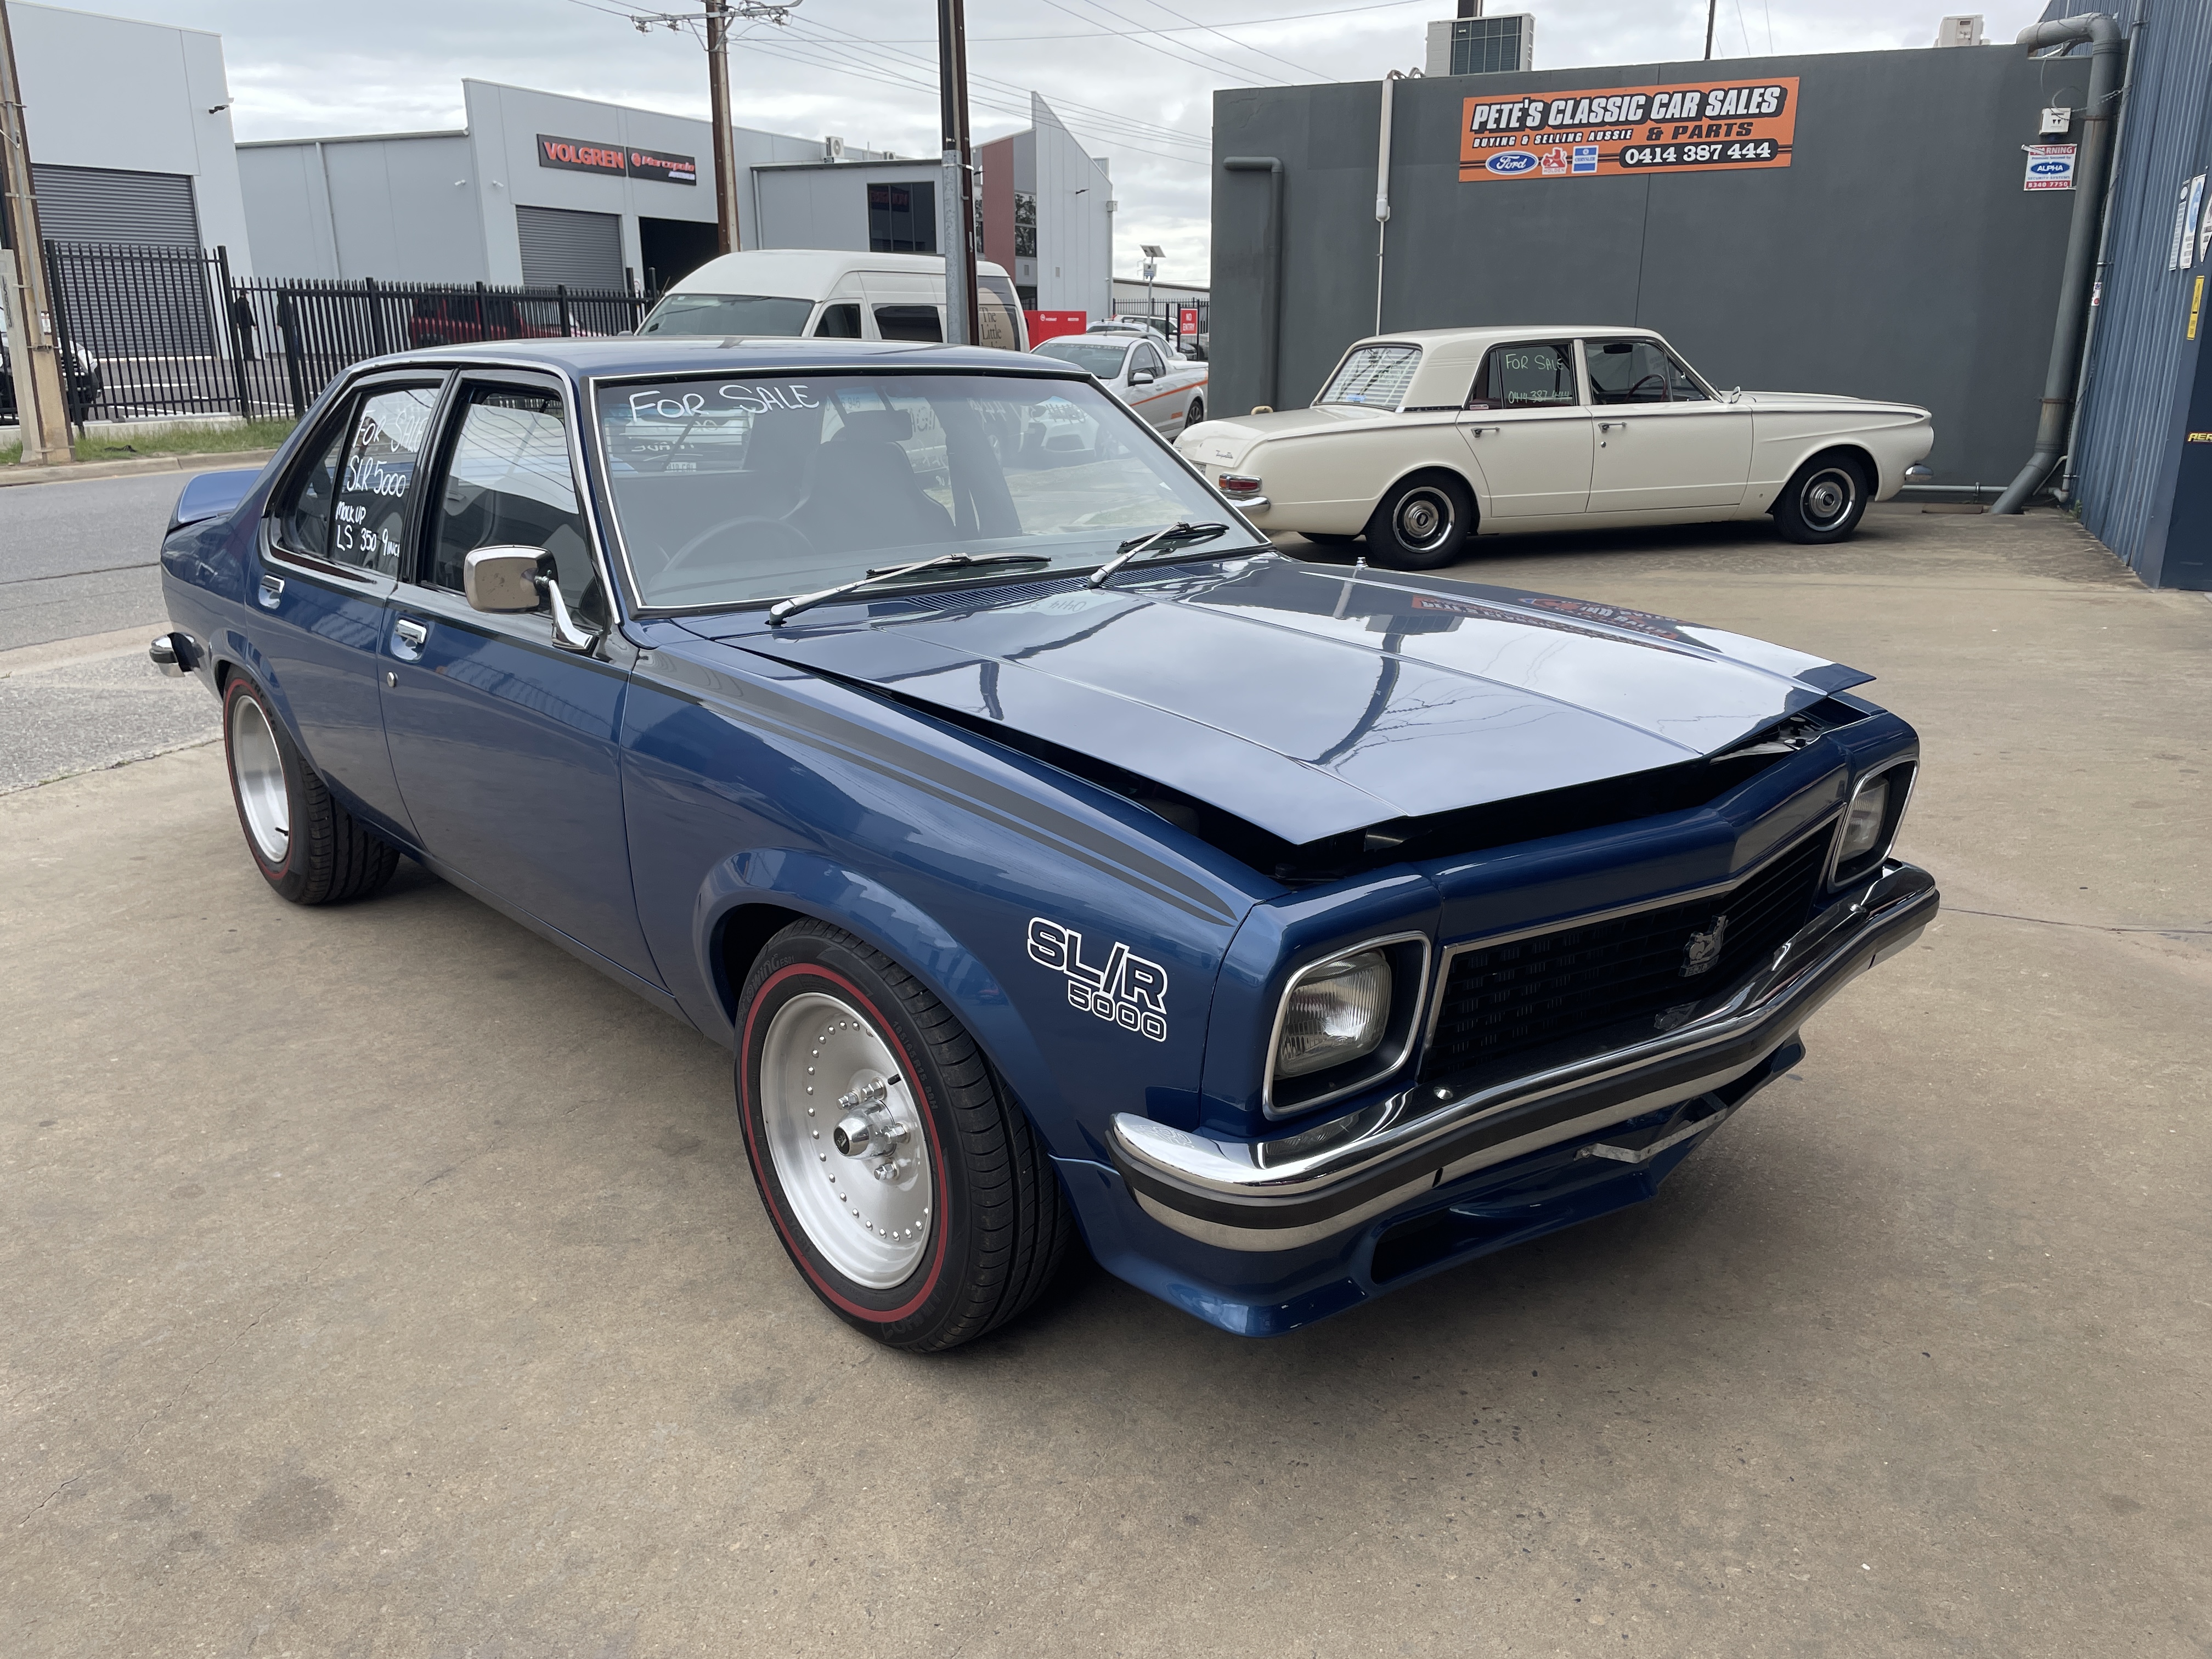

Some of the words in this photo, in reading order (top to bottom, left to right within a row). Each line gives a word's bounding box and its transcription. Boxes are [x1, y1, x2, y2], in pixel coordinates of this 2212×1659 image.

[1471, 99, 1544, 130] PETE'S
[1548, 95, 1646, 126] CLASSIC
[1650, 92, 1701, 120] CAR
[1705, 87, 1781, 117] SALES
[1473, 136, 1516, 148] BUYING
[1521, 135, 1530, 146] &
[1534, 132, 1583, 145] SELLING
[1587, 129, 1633, 142] AUSSIE
[1646, 127, 1663, 141] &
[1672, 122, 1753, 140] PARTS
[544, 142, 624, 169] VOLGREN
[1496, 156, 1526, 170] Ford
[1625, 148, 1677, 164] 0414
[1683, 144, 1723, 161] 387
[1728, 142, 1771, 159] 444
[979, 307, 996, 323] The
[981, 324, 1001, 340] Little
[1505, 354, 1528, 370] FOR
[1534, 354, 1564, 371] SALE
[629, 390, 709, 422] FOR
[719, 385, 819, 413] SALE
[1530, 390, 1548, 403] 387
[352, 409, 386, 448] FOR
[391, 408, 428, 453] SALE
[347, 455, 373, 492] SLR
[374, 460, 406, 497] 5000
[337, 524, 353, 551] LS
[360, 527, 377, 552] 350
[1027, 917, 1167, 1014] SL/R
[1068, 979, 1166, 1042] 5000
